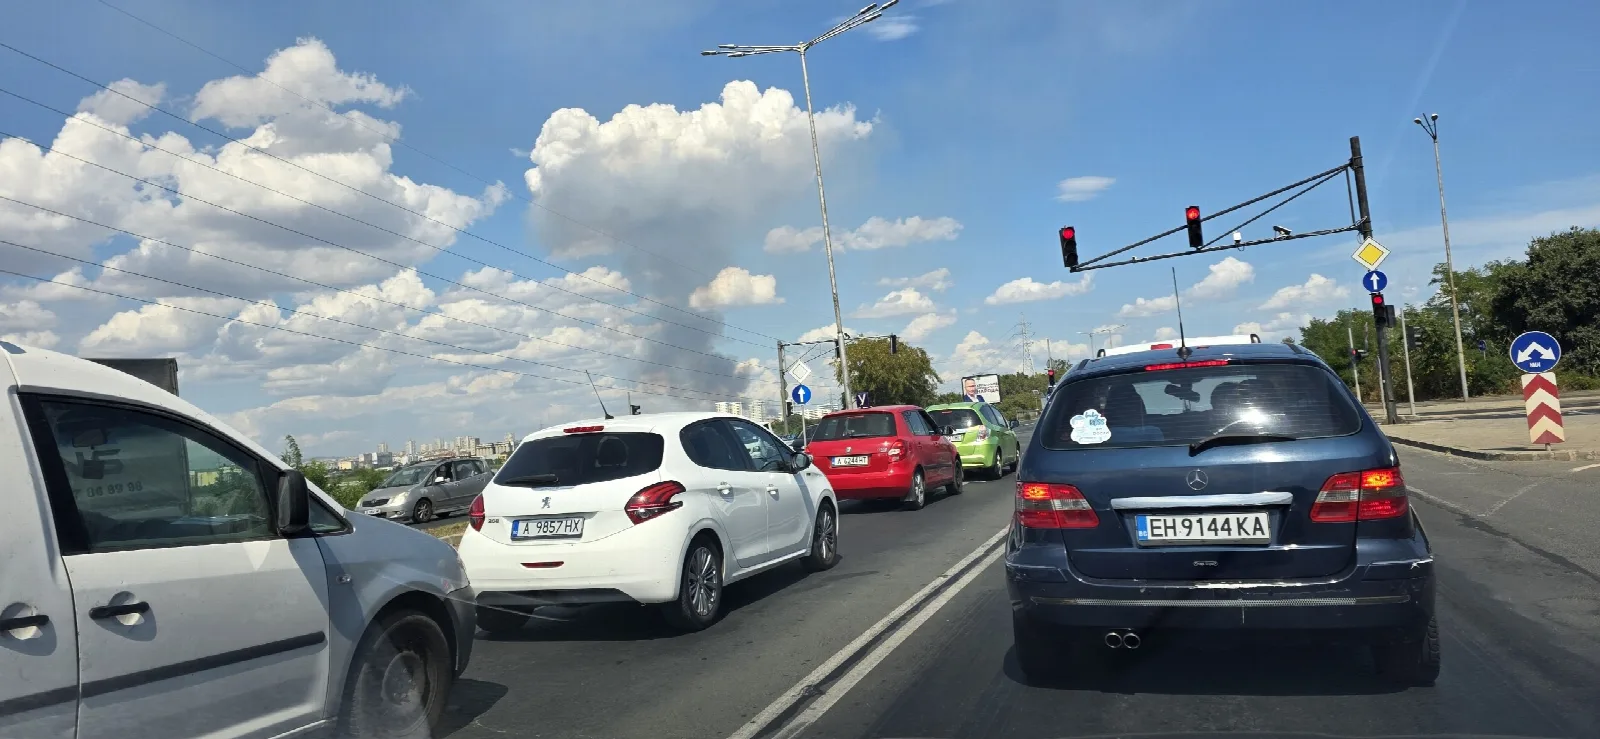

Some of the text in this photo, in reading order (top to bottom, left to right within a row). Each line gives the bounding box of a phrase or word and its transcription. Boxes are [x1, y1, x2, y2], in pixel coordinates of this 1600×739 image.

[1150, 518, 1176, 537] EH
[1181, 517, 1232, 537] 9144
[1236, 516, 1266, 536] KA
